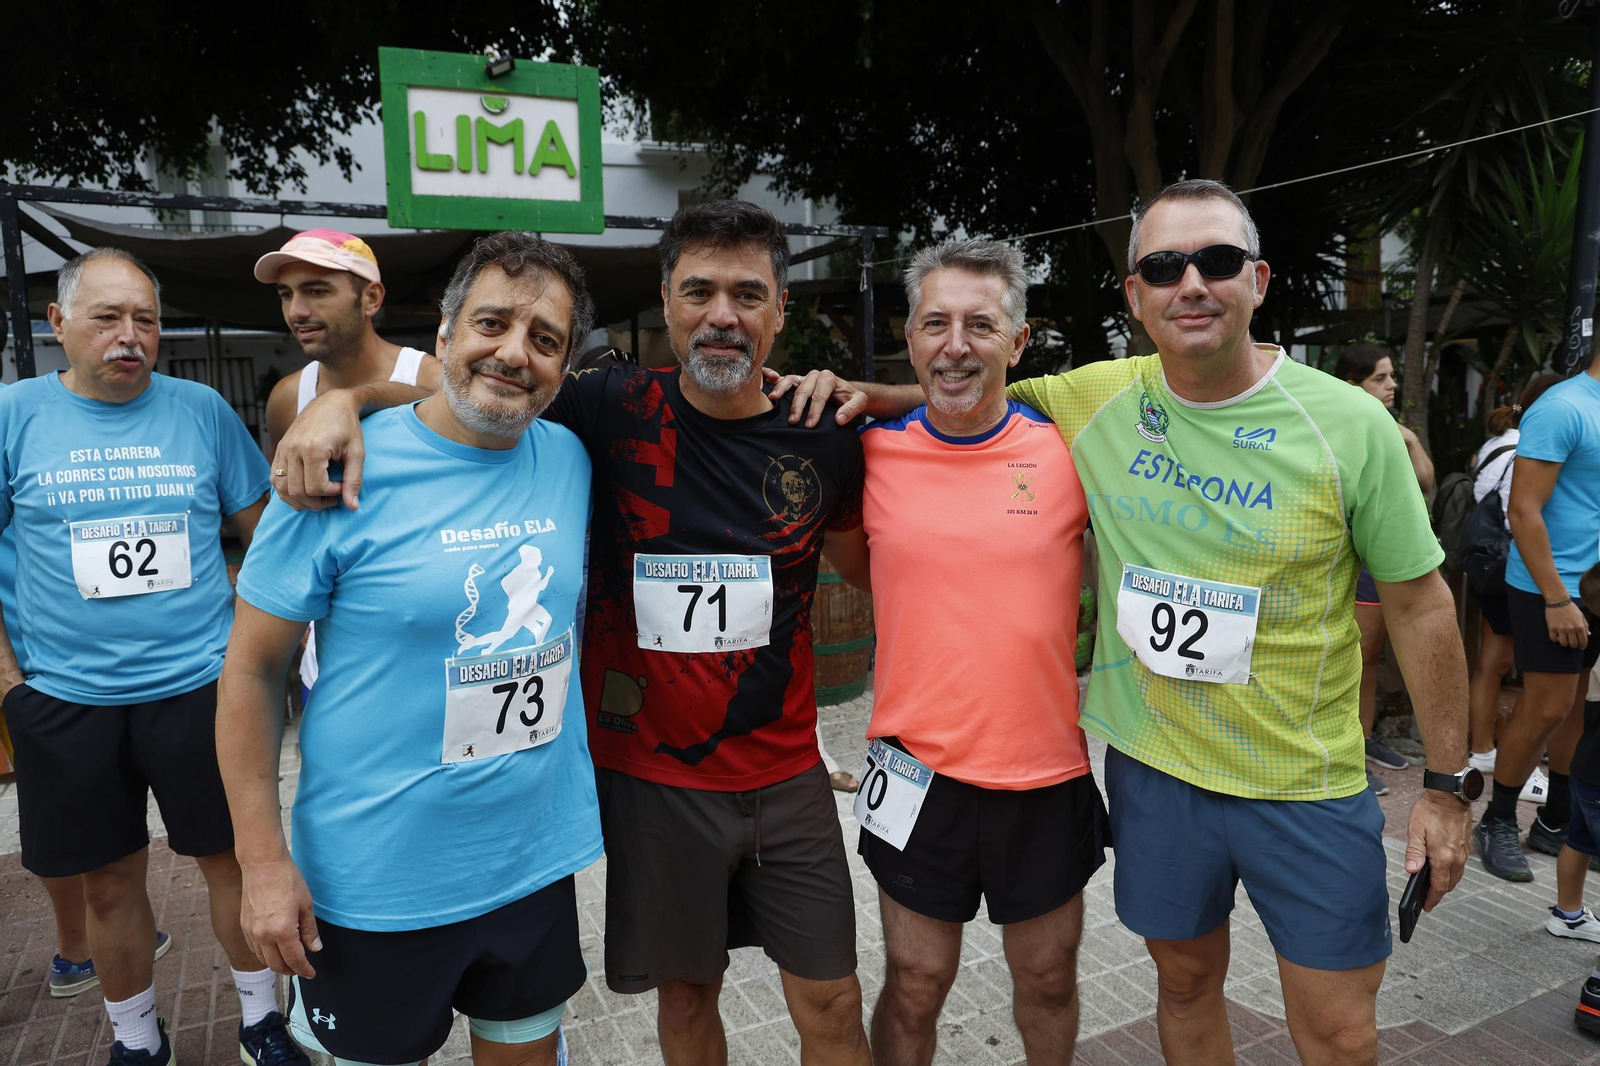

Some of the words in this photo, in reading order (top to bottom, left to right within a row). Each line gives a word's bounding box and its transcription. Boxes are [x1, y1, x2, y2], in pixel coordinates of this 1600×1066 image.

[414, 110, 577, 178] LIMA
[70, 448, 101, 463] ESTA
[105, 446, 161, 461] CARRERA
[1232, 439, 1272, 451] SURAL
[38, 472, 53, 486] LA
[56, 468, 105, 484] CORRES
[109, 466, 134, 481] CON
[138, 464, 196, 479] NOSOTROS
[1128, 449, 1273, 510] ESTEPONA
[58, 490, 76, 505] VA
[79, 488, 105, 503] POR
[108, 487, 121, 500] TI
[123, 485, 151, 499] TITO
[155, 483, 183, 497] JUAN
[81, 523, 120, 540] DESAFÍO
[123, 521, 148, 539] ELA
[149, 520, 178, 534] TARIFA
[440, 520, 521, 545] Desafío
[524, 518, 557, 535] ELA
[108, 538, 159, 579] 62
[462, 544, 478, 552] paso
[479, 542, 500, 550] cuenta
[645, 561, 689, 578] DESAFÍO
[692, 560, 720, 583] ELA
[722, 563, 759, 579] TARIFA
[1131, 573, 1171, 597] DESAFÍO
[1173, 580, 1201, 608] ELA
[1203, 589, 1244, 611] TARIFA
[677, 584, 726, 632] 71
[723, 637, 748, 645] TARIFA
[1150, 602, 1208, 661] 92
[459, 660, 509, 684] DESAFÍO
[512, 655, 539, 679] ELA
[540, 643, 565, 667] TARIFA
[1194, 668, 1223, 677] TARIFA
[492, 675, 545, 735] 73
[599, 713, 610, 723] La
[613, 716, 638, 731] Oliva
[890, 756, 921, 783] TARIFA
[858, 755, 888, 811] 70
[870, 819, 889, 834] TARIFA
